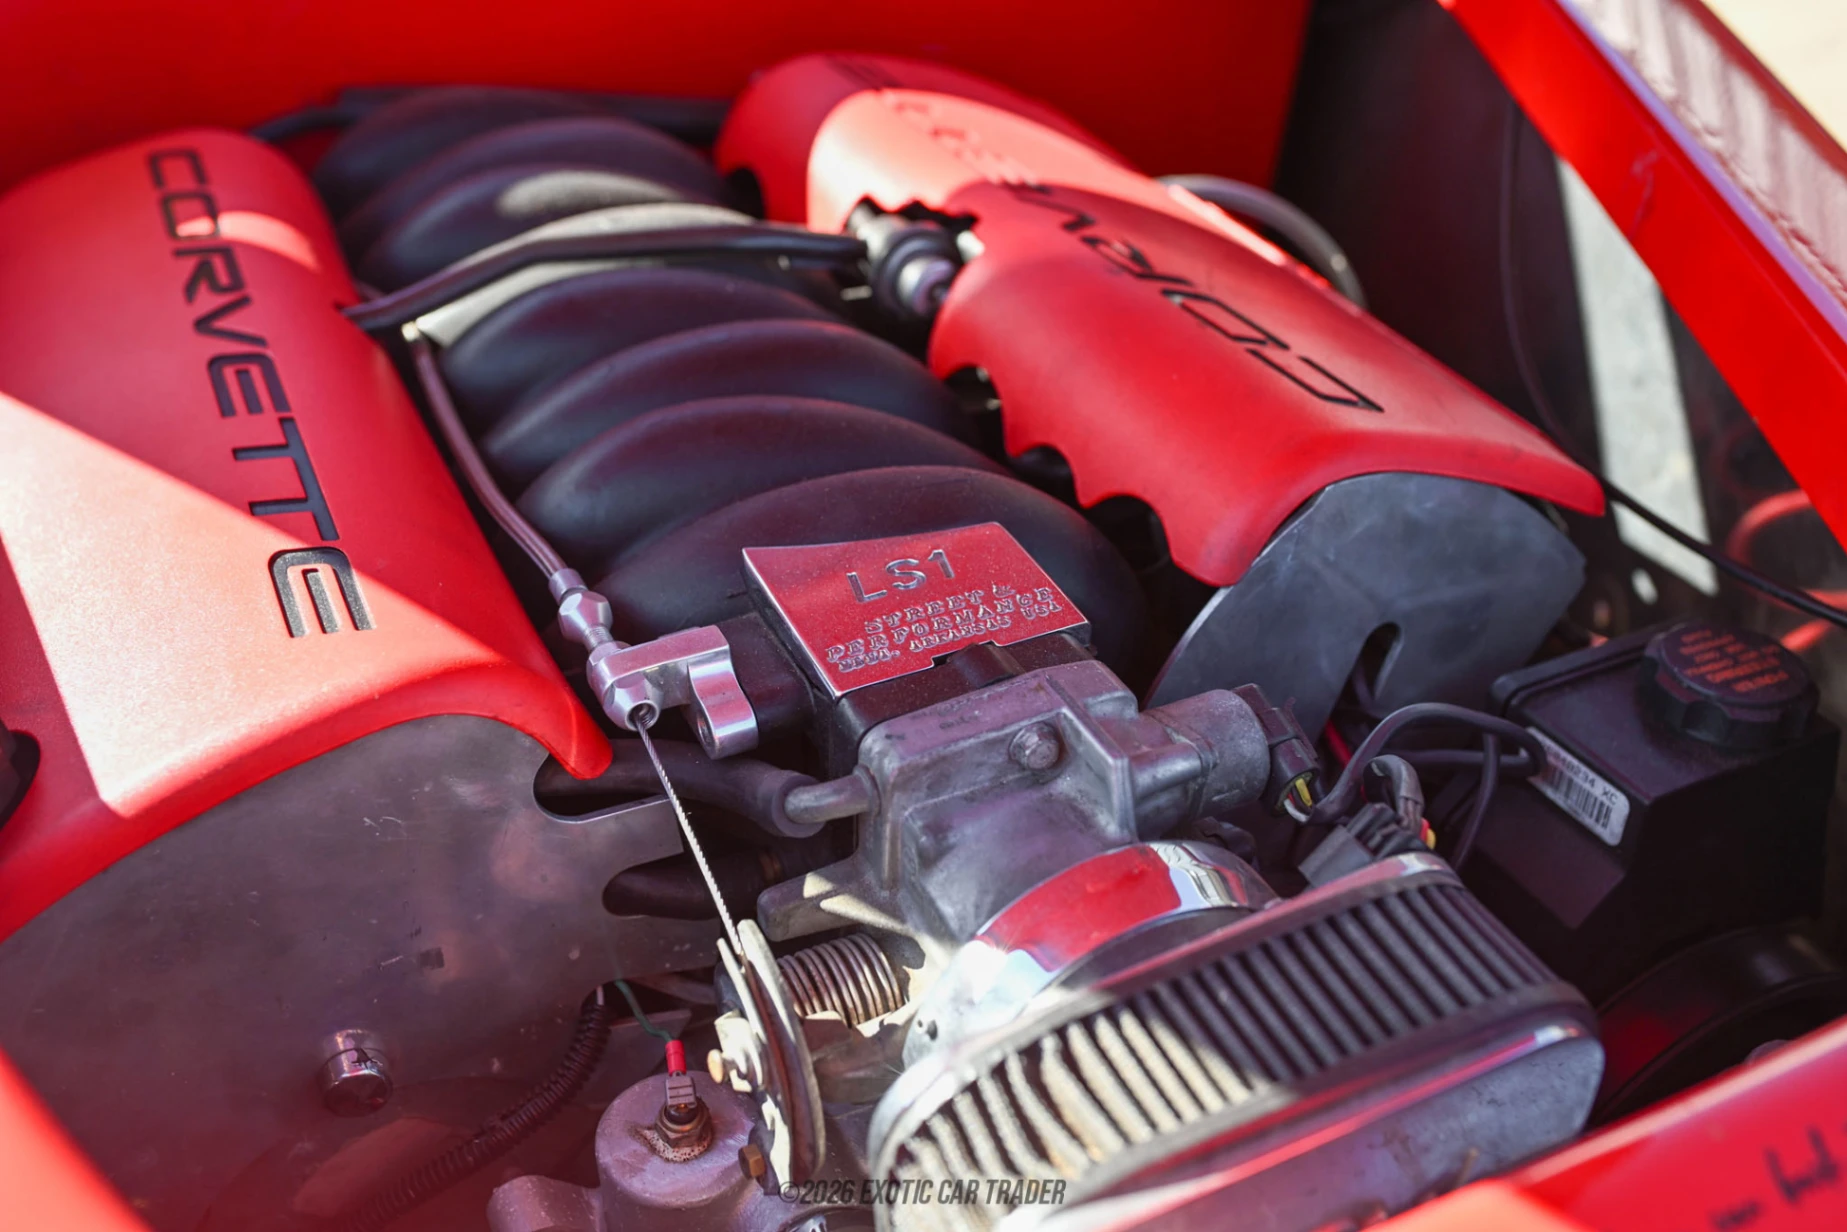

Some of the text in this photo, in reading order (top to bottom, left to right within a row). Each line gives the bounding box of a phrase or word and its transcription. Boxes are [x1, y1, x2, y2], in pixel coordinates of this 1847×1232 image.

[146, 147, 377, 639] CORVETTE
[846, 549, 955, 603] LS1
[826, 587, 1054, 663] PERFORMANCE
[864, 580, 1016, 634] STREET &
[909, 616, 1012, 653] ARKANSAS
[1020, 600, 1062, 620] USA
